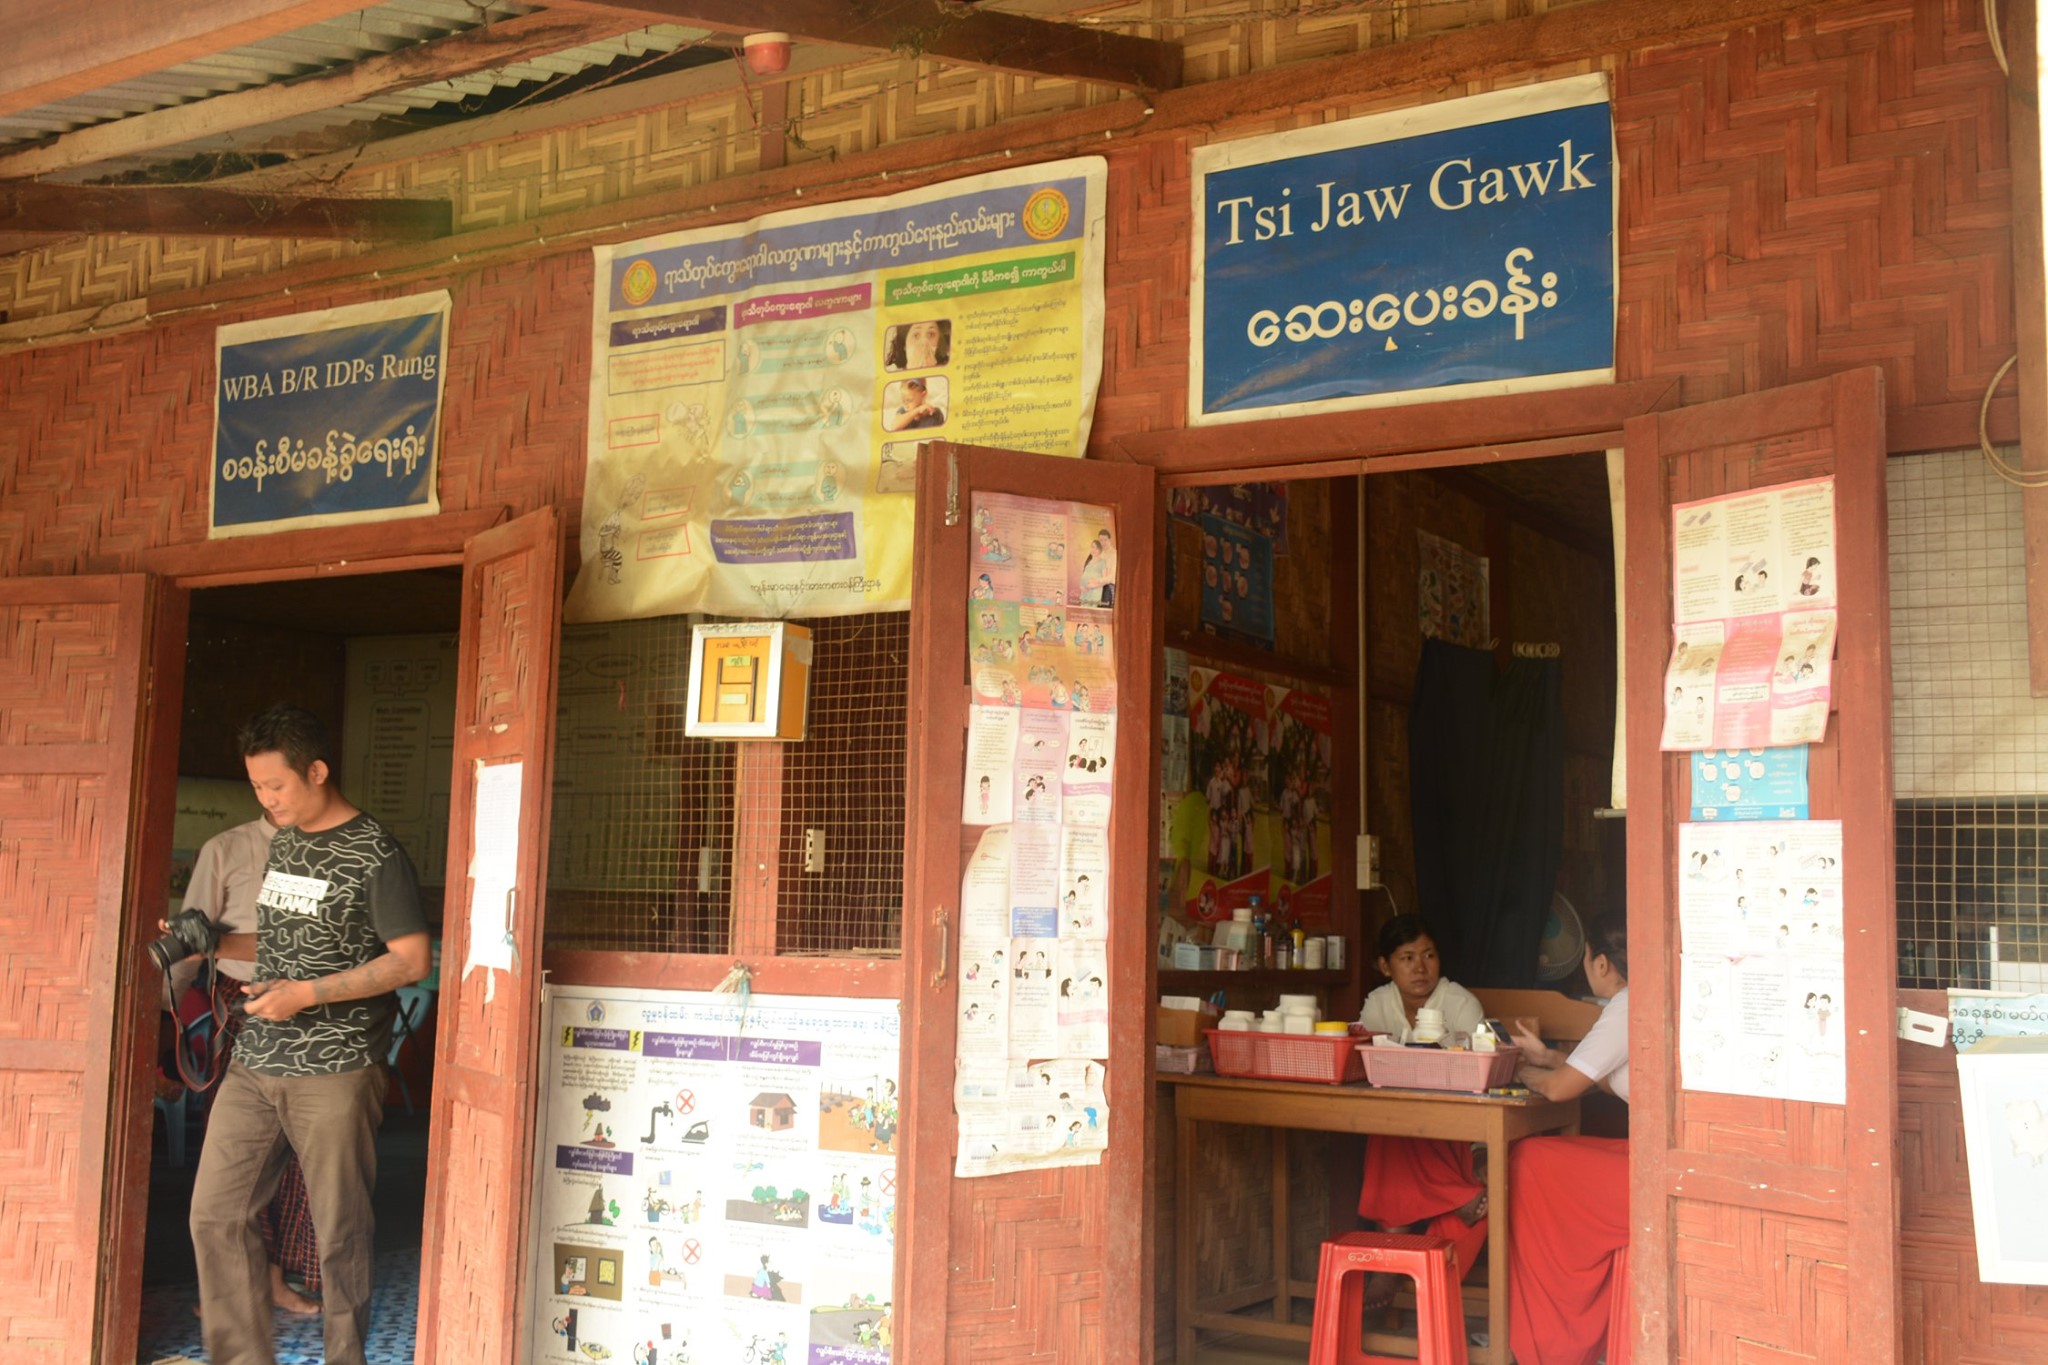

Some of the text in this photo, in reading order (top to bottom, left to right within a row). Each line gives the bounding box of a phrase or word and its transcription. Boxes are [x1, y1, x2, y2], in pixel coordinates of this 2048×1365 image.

[1217, 138, 1597, 246] Tsi Jaw Gawk
[1246, 247, 1559, 348] ဆေးပေးခန်း
[223, 353, 437, 403] WBA B/R IDPs Rung
